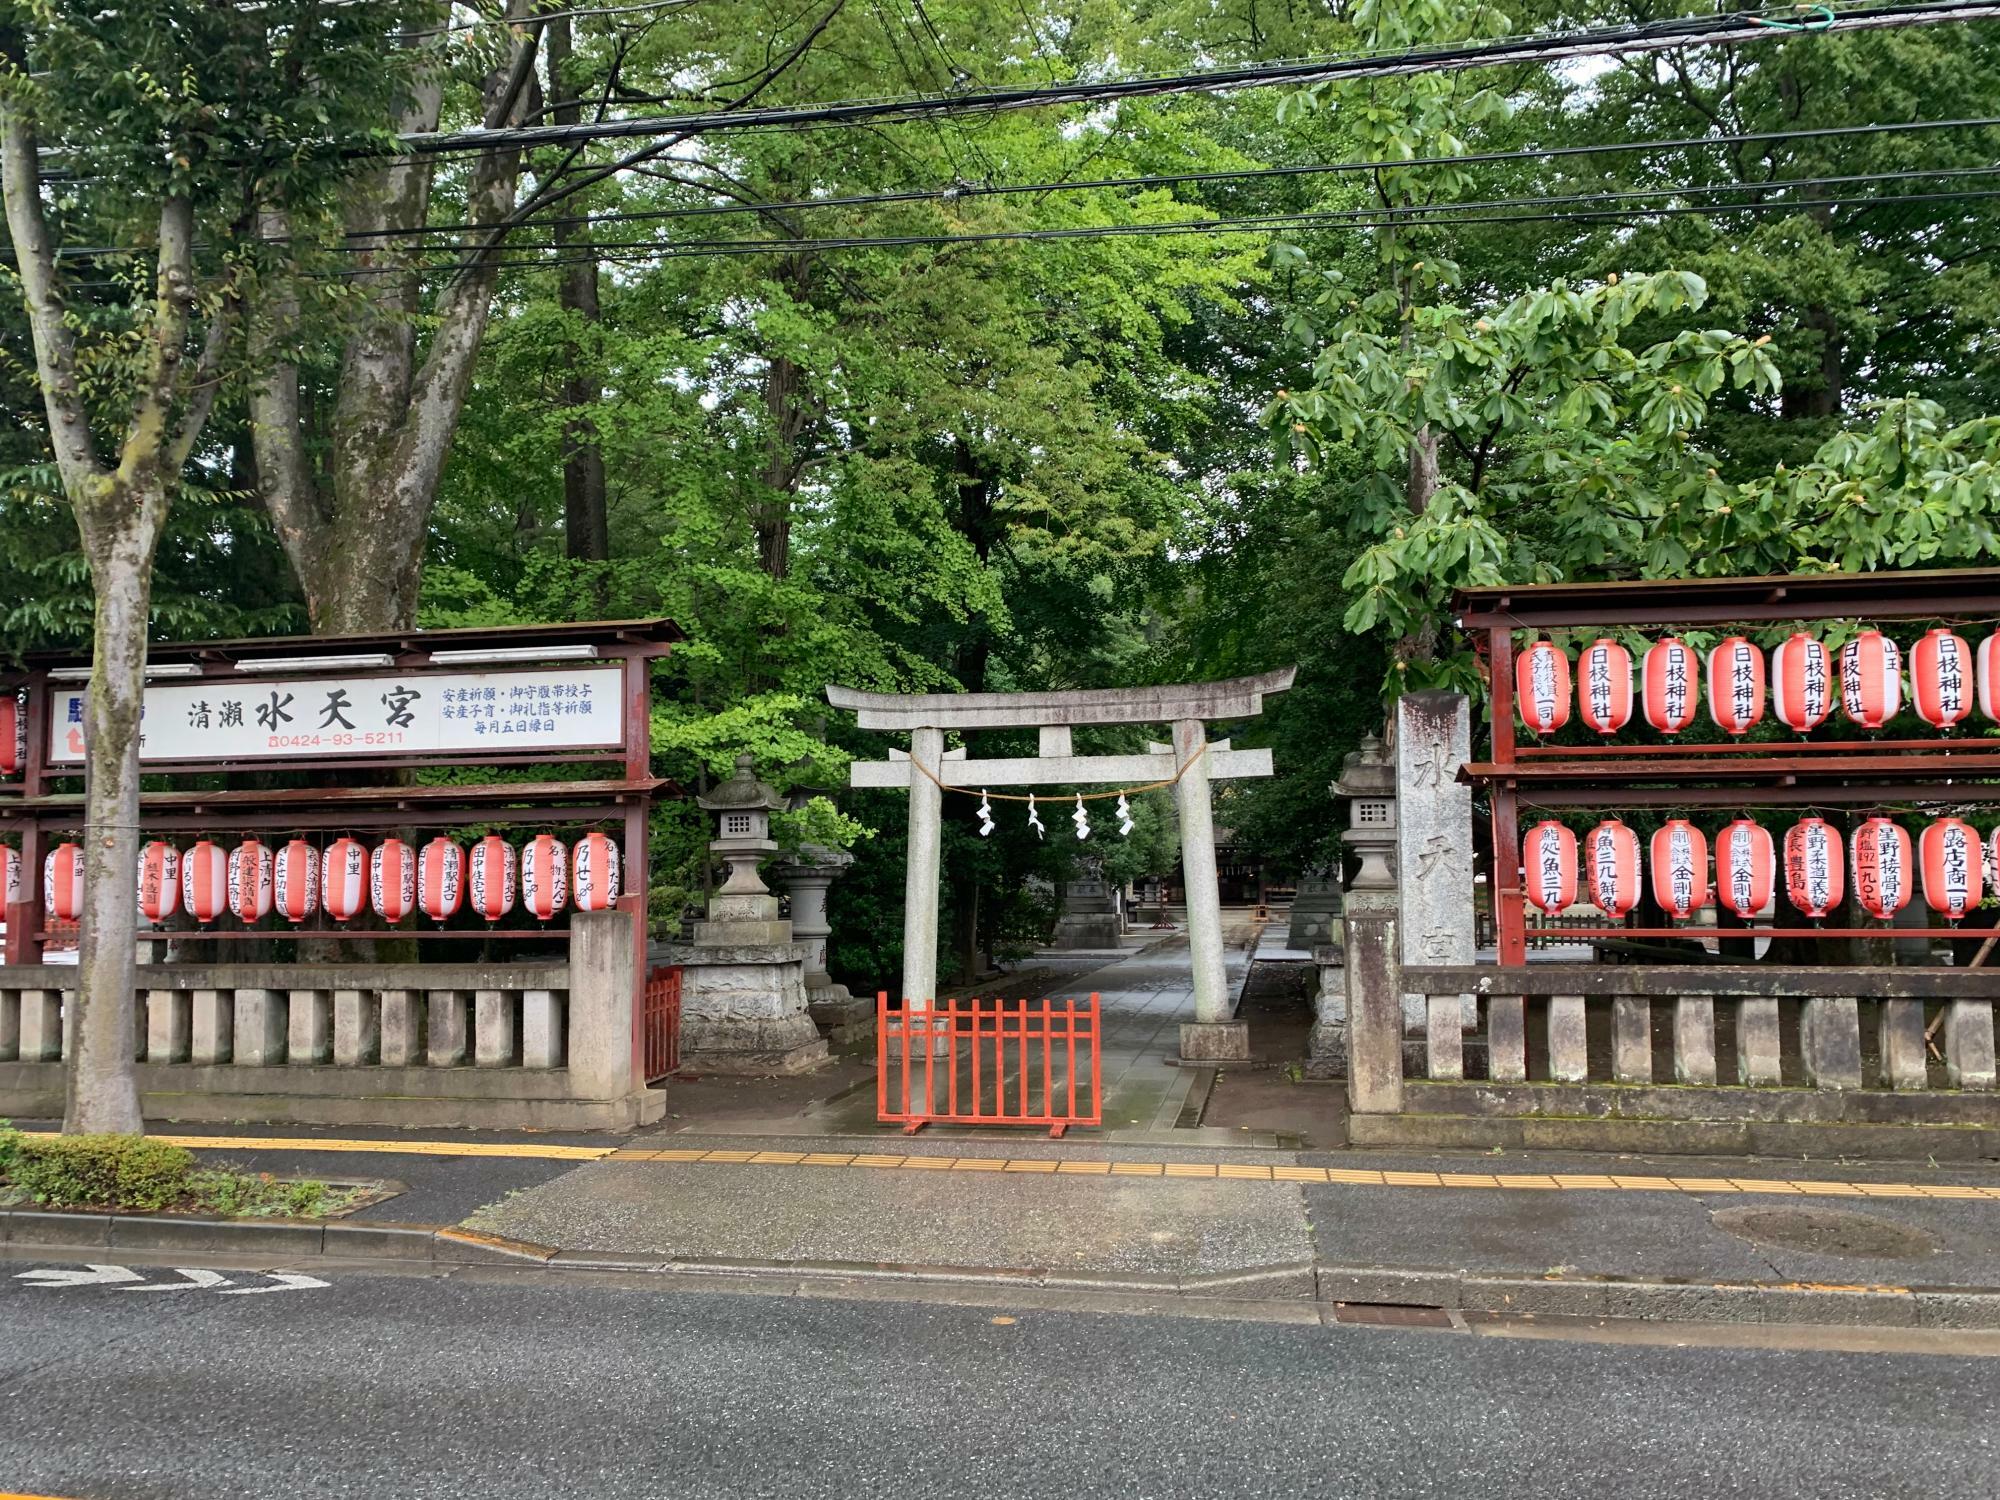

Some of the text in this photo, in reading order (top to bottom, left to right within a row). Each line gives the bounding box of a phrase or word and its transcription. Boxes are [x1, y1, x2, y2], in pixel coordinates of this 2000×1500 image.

[1589, 648, 1614, 719] 日枝神社
[1664, 647, 1688, 719] 日枝神社
[1732, 647, 1754, 719] 日枝神社
[1803, 644, 1826, 716] 日枝神社
[1843, 641, 1868, 714] 日枝神社
[1884, 641, 1898, 671] 山王
[1938, 638, 1963, 712] 日枝神社
[164, 853, 177, 880] 中里
[347, 848, 361, 876] 中里
[444, 847, 459, 901] 清瀬駅北口
[1672, 865, 1695, 909] 金剛組
[1731, 867, 1754, 909] 金剛組
[1879, 827, 1901, 909] 星野接骨院
[1943, 828, 1968, 911] 露店商一同
